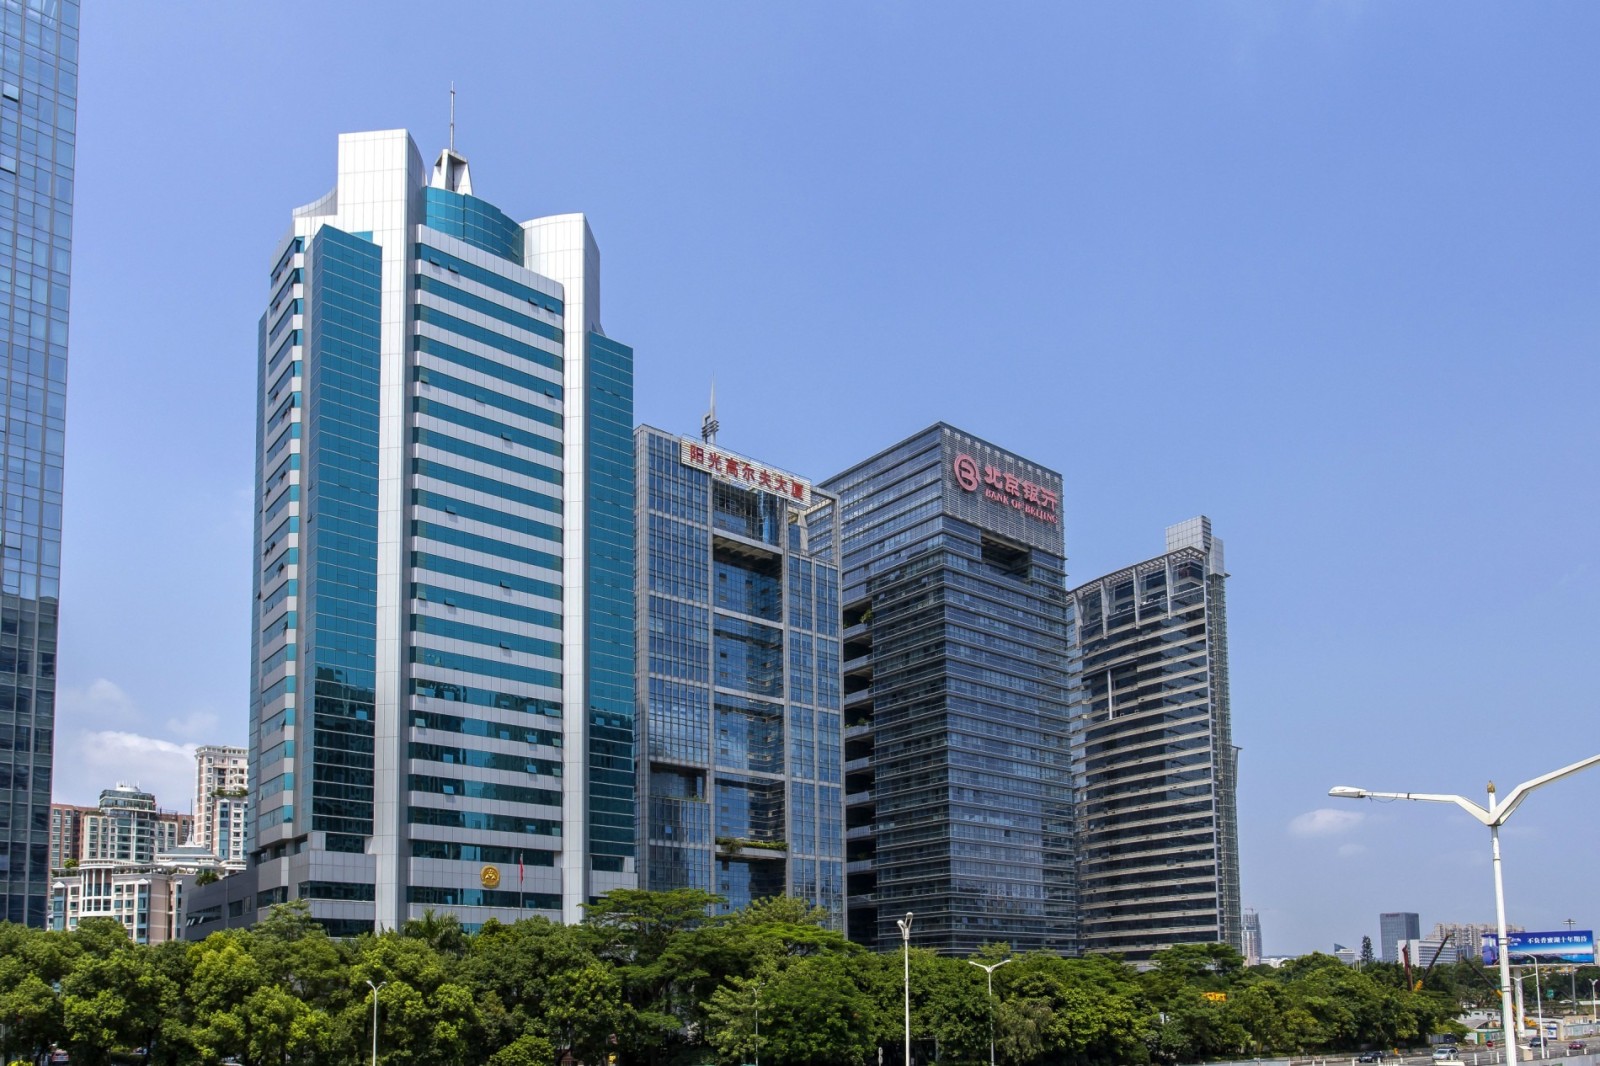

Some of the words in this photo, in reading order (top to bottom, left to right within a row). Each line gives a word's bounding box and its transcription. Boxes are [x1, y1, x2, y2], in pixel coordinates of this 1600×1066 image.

[689, 444, 803, 500] 阳光高尔夫大厦
[984, 465, 1057, 511] 北京银行
[985, 488, 1008, 505] BANK
[1011, 499, 1022, 509] OF
[1025, 504, 1057, 523] BEIJING
